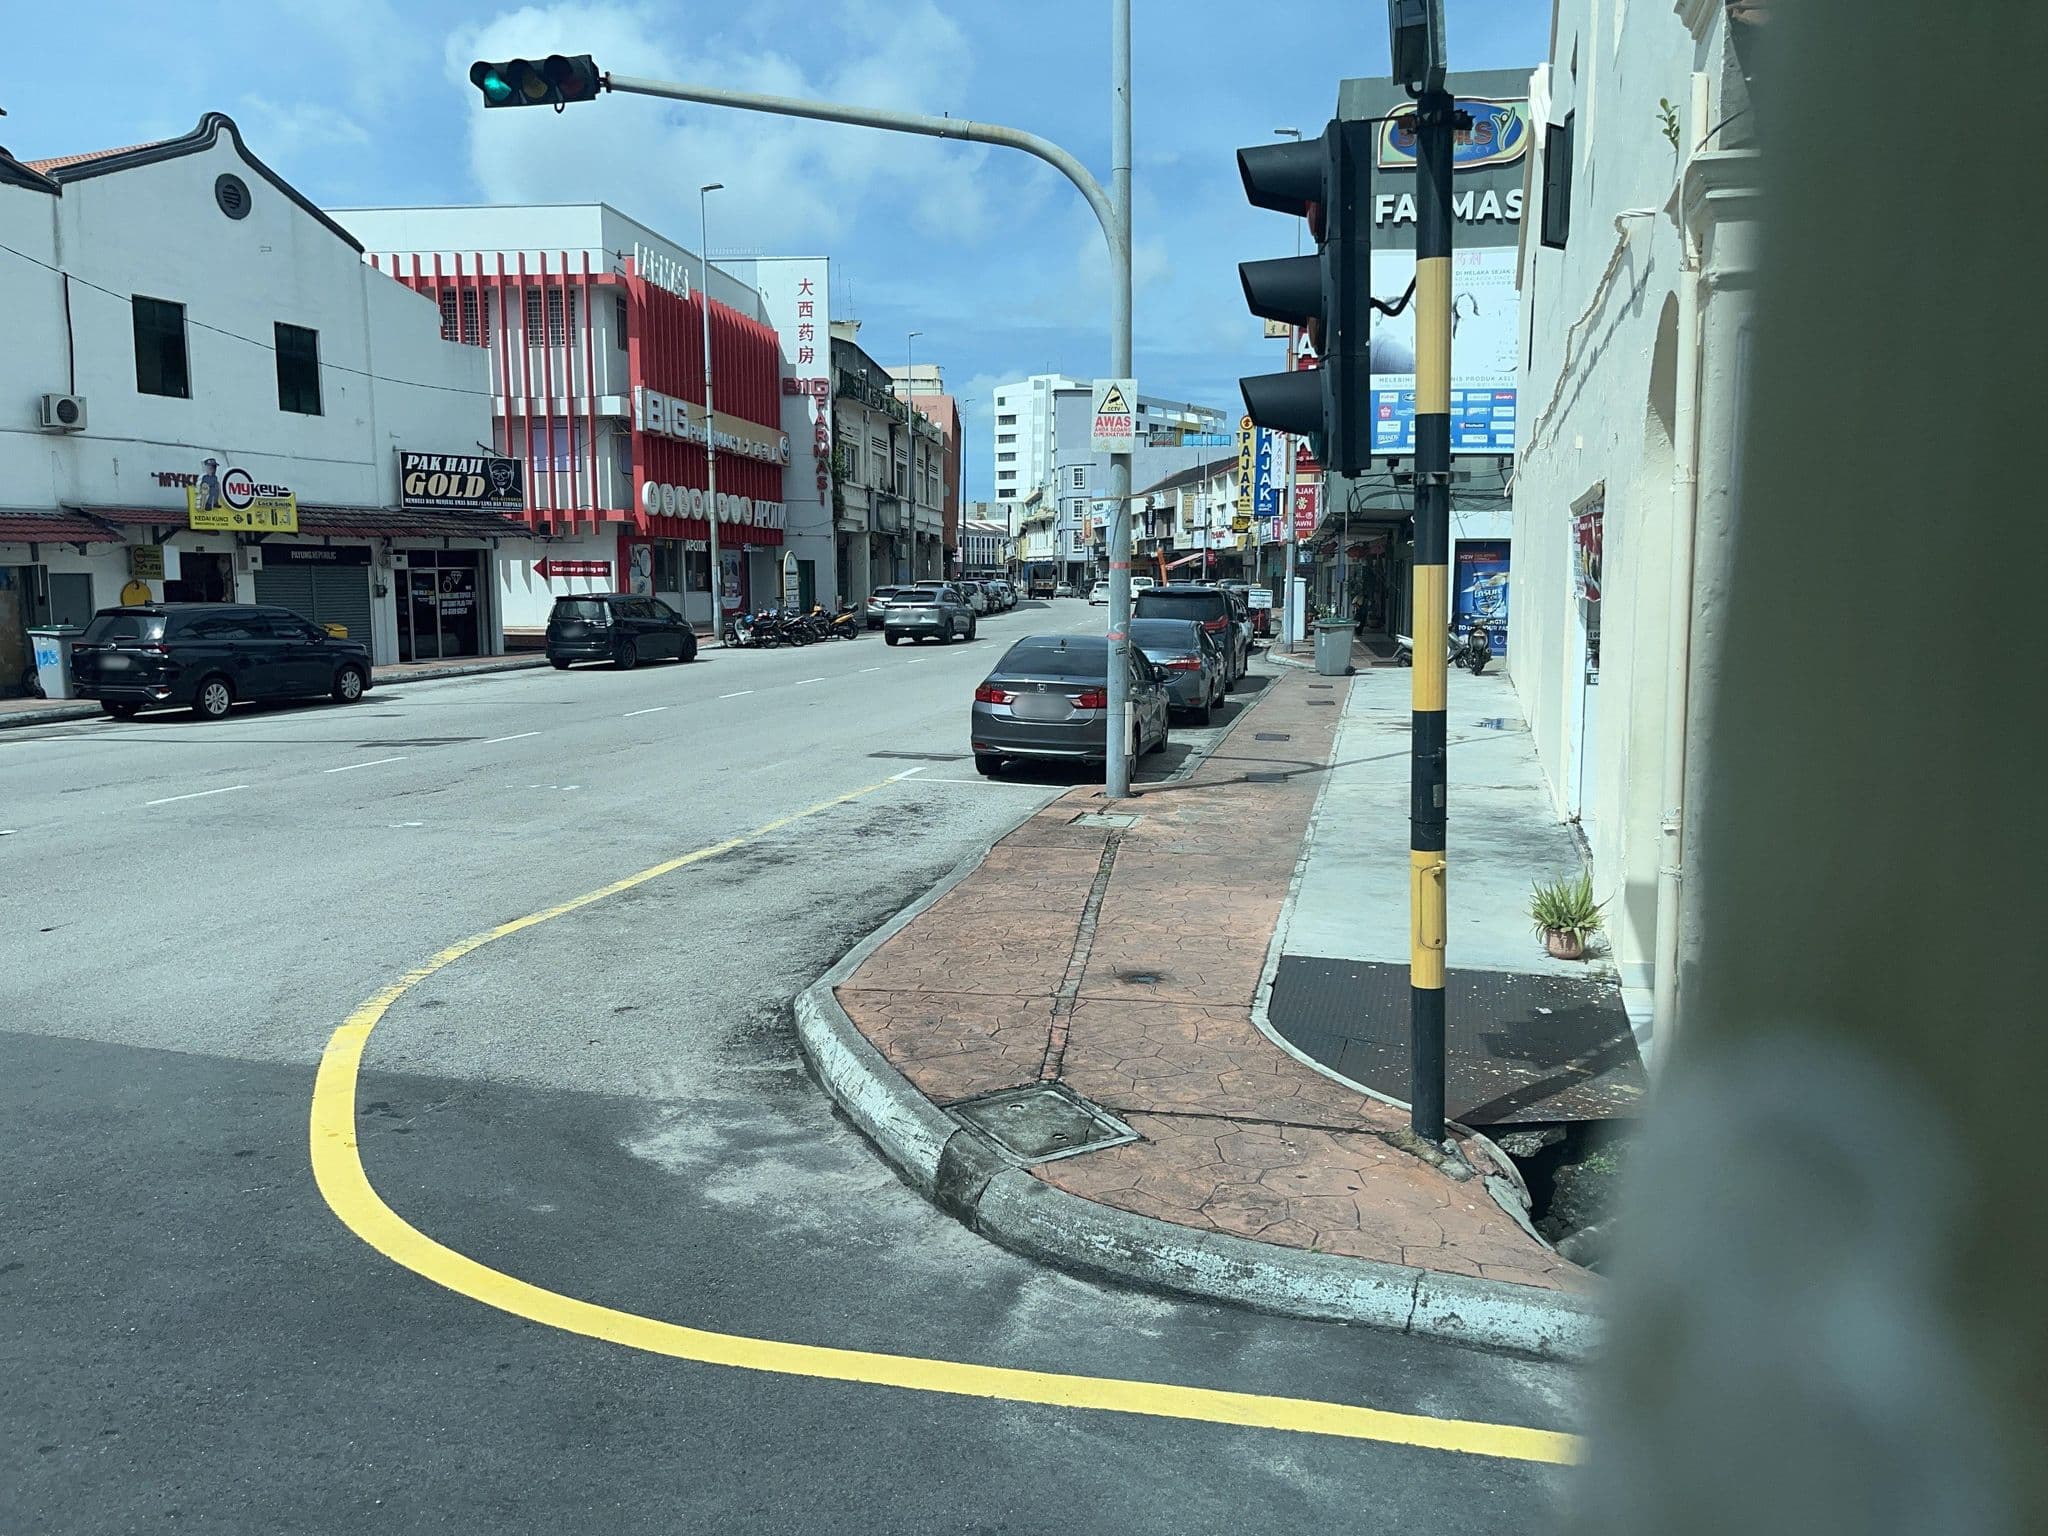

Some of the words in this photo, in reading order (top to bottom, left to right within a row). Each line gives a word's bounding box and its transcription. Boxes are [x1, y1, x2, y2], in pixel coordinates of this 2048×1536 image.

[1376, 189, 1523, 223] FAMAS
[797, 278, 814, 364] 大西药房
[783, 378, 829, 395] BIG
[647, 390, 688, 438] BIG
[1096, 416, 1131, 427] AWAS
[405, 455, 442, 471] PAK
[444, 457, 484, 475] HAJI
[813, 396, 829, 506] FARMASI
[1240, 432, 1251, 497] PAJAK
[1260, 428, 1273, 500] PAJAK
[405, 472, 486, 497] GOLD
[754, 500, 788, 529] APOTIK
